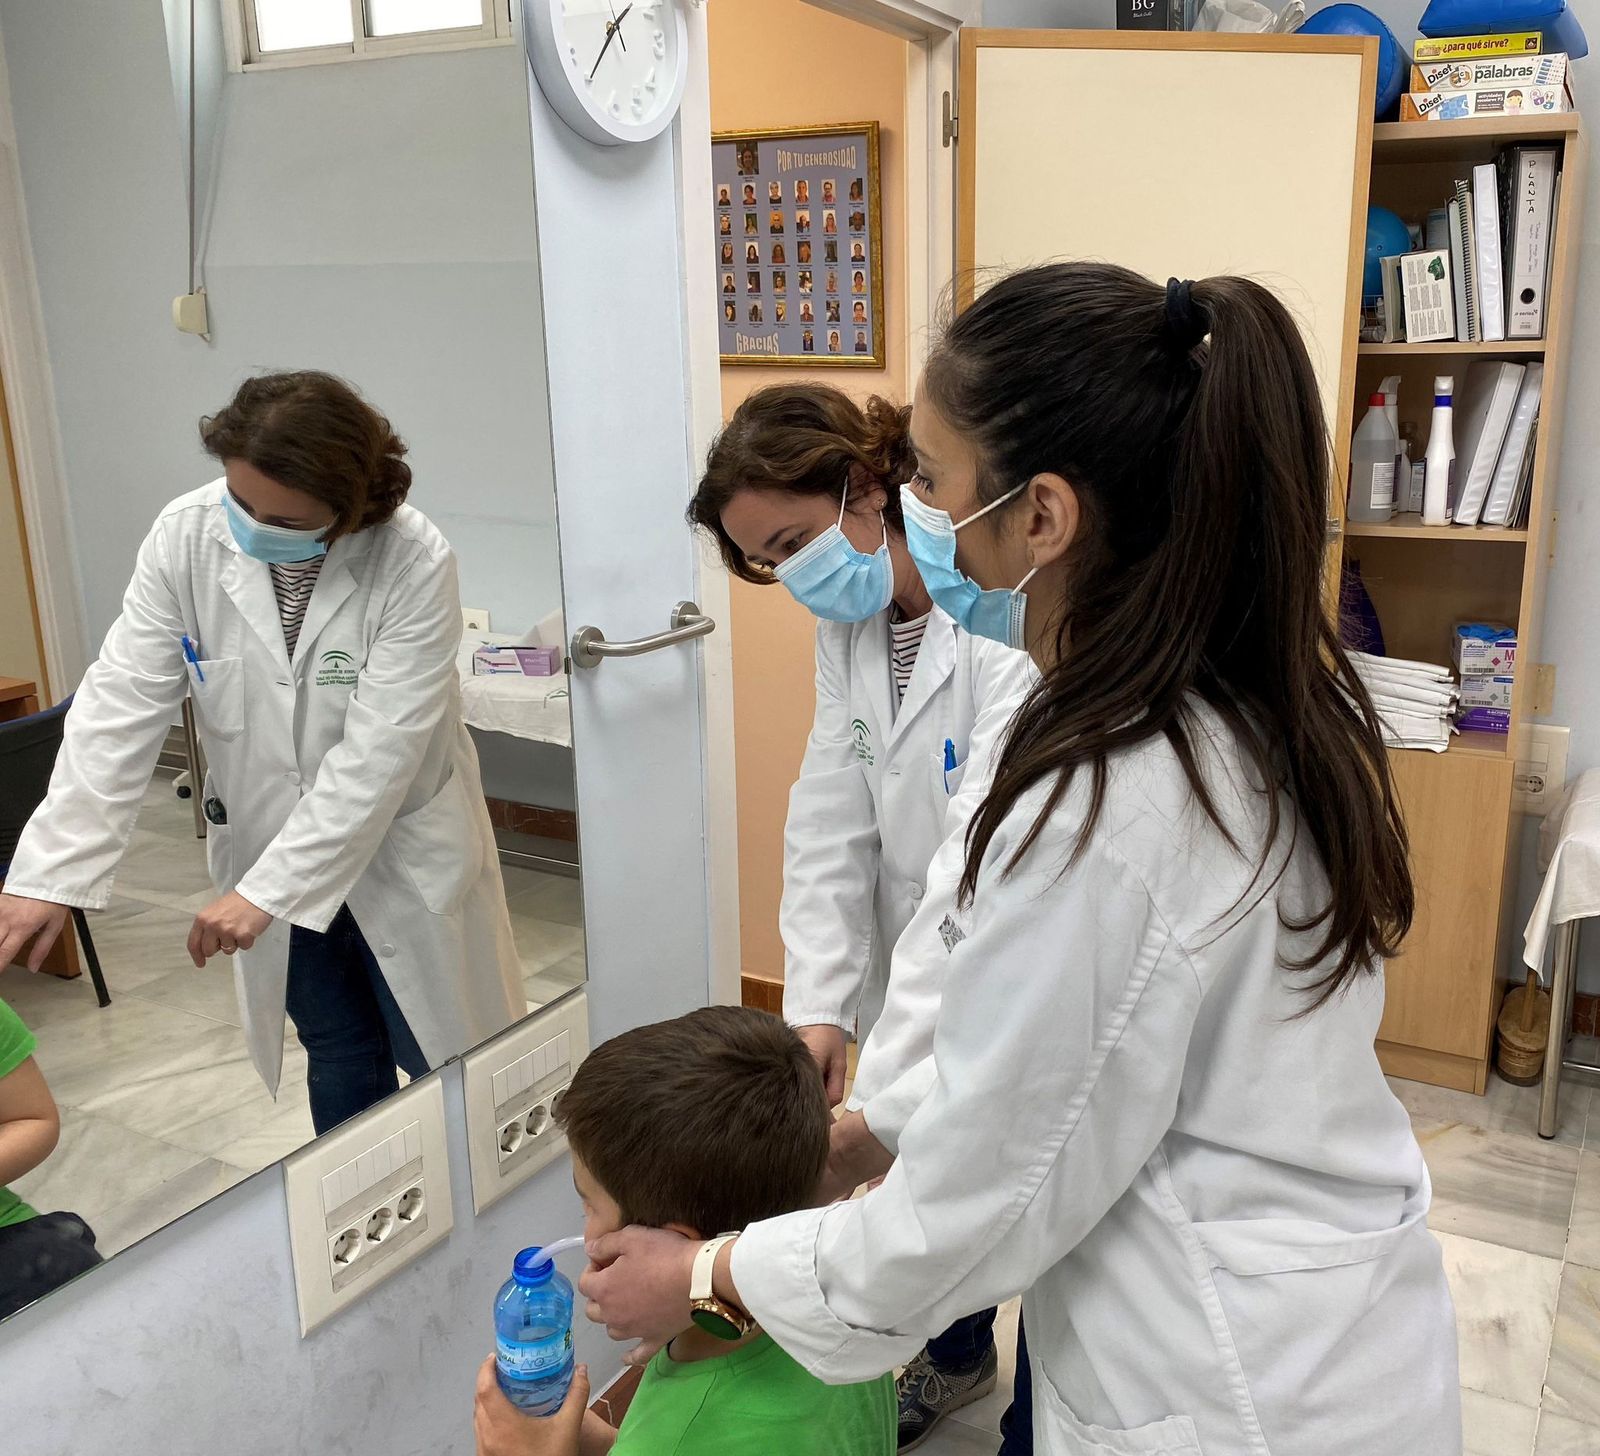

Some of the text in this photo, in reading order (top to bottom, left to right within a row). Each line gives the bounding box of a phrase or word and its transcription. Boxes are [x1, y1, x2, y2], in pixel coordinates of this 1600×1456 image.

[1132, 0, 1155, 10] BG
[1442, 43, 1466, 53] ¿para
[1466, 40, 1482, 52] qué
[1482, 38, 1509, 49] sirve?
[1427, 64, 1453, 84] Diset
[1475, 64, 1534, 83] palabras
[1418, 93, 1443, 113] Diset
[777, 145, 857, 174] POR TU GENEROSIDAD
[1526, 159, 1537, 214] PLANTA
[735, 332, 779, 356] GRACIAS
[1505, 650, 1514, 661] M
[1504, 686, 1510, 695] L
